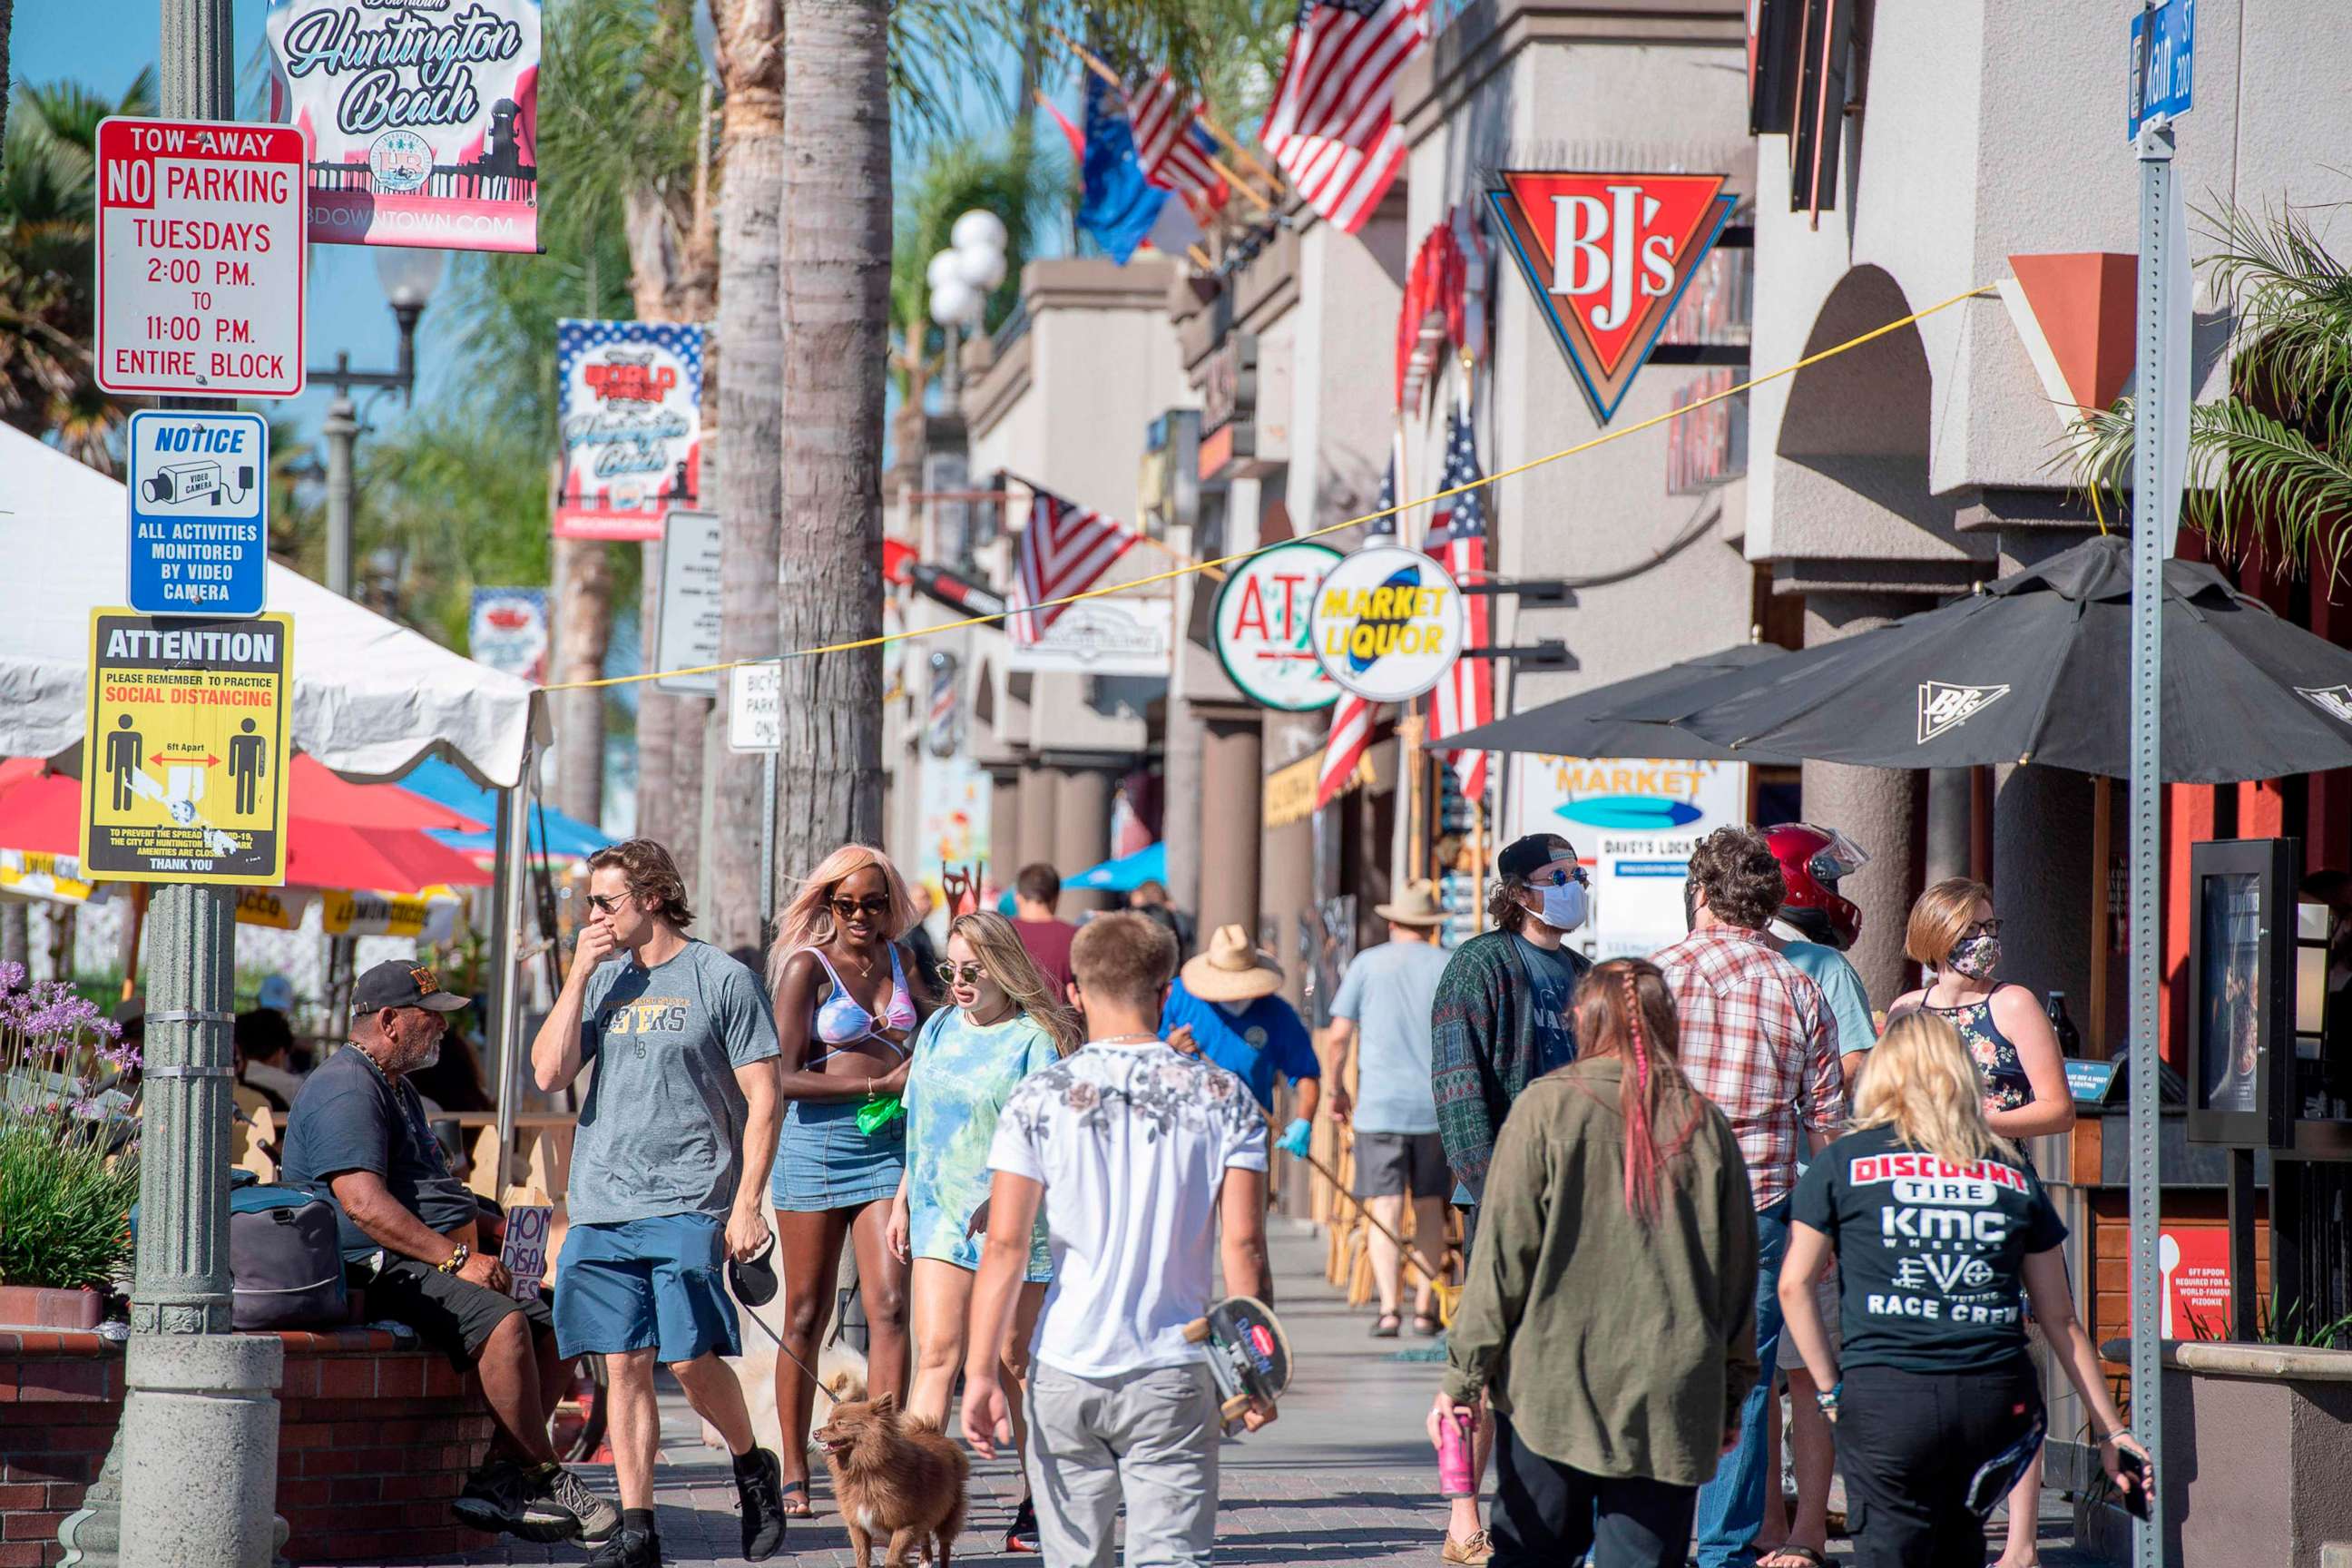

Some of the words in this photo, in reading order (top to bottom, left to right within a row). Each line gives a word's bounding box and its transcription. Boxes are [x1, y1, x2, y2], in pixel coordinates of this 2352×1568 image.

[284, 5, 523, 86] Huntington
[2175, 52, 2190, 99] 200
[337, 65, 480, 134] Beach
[130, 127, 274, 158] TOW-AWAY
[107, 159, 152, 204] NO
[167, 166, 288, 204] PARKING
[132, 219, 271, 253] TUESDAYS
[1548, 185, 1676, 332] BJ's
[147, 258, 201, 283] 2:00
[215, 261, 255, 286] P.M.
[191, 291, 211, 310] TO
[147, 316, 201, 341] 11:00
[215, 318, 255, 343] P.M.
[116, 349, 196, 376] ENTIRE
[211, 353, 284, 379] BLOCK
[154, 427, 246, 454] NOTICE
[185, 481, 212, 494] CAMERA
[190, 473, 209, 483] VIDEO
[138, 523, 166, 539] ALL
[172, 524, 258, 542] ACTIVITIES
[152, 544, 243, 561] MONITORED
[162, 564, 181, 580] BY
[188, 564, 233, 581] VIDEO
[163, 583, 230, 601] CAMERA
[1321, 586, 1450, 620] MARKET
[1233, 573, 1323, 641] AT
[105, 629, 275, 662] ATTENTION
[1325, 623, 1445, 659] LIQUOR
[106, 673, 144, 684] PLEASE
[146, 674, 203, 686] REMEMBER
[209, 676, 221, 686] TO
[223, 676, 272, 688] PRACTICE
[105, 687, 165, 704] SOCIAL
[170, 688, 272, 707] DISTANCING
[167, 742, 180, 751] 6ft
[181, 743, 204, 753] Apart
[1555, 769, 1707, 794] MARKET
[110, 828, 121, 837] TO
[122, 829, 156, 838] PREVENT
[157, 830, 171, 838] THE
[172, 830, 202, 839] SPREAD
[110, 838, 125, 846] THE
[144, 838, 155, 847] OF
[156, 839, 203, 848] HUNTINGTON
[137, 848, 178, 856] AMENITIES
[178, 848, 193, 857] ARE
[150, 858, 187, 870] THANK
[190, 860, 213, 871] YOU
[1906, 1182, 1983, 1200] TIRE
[1867, 1294, 1939, 1319] RACE
